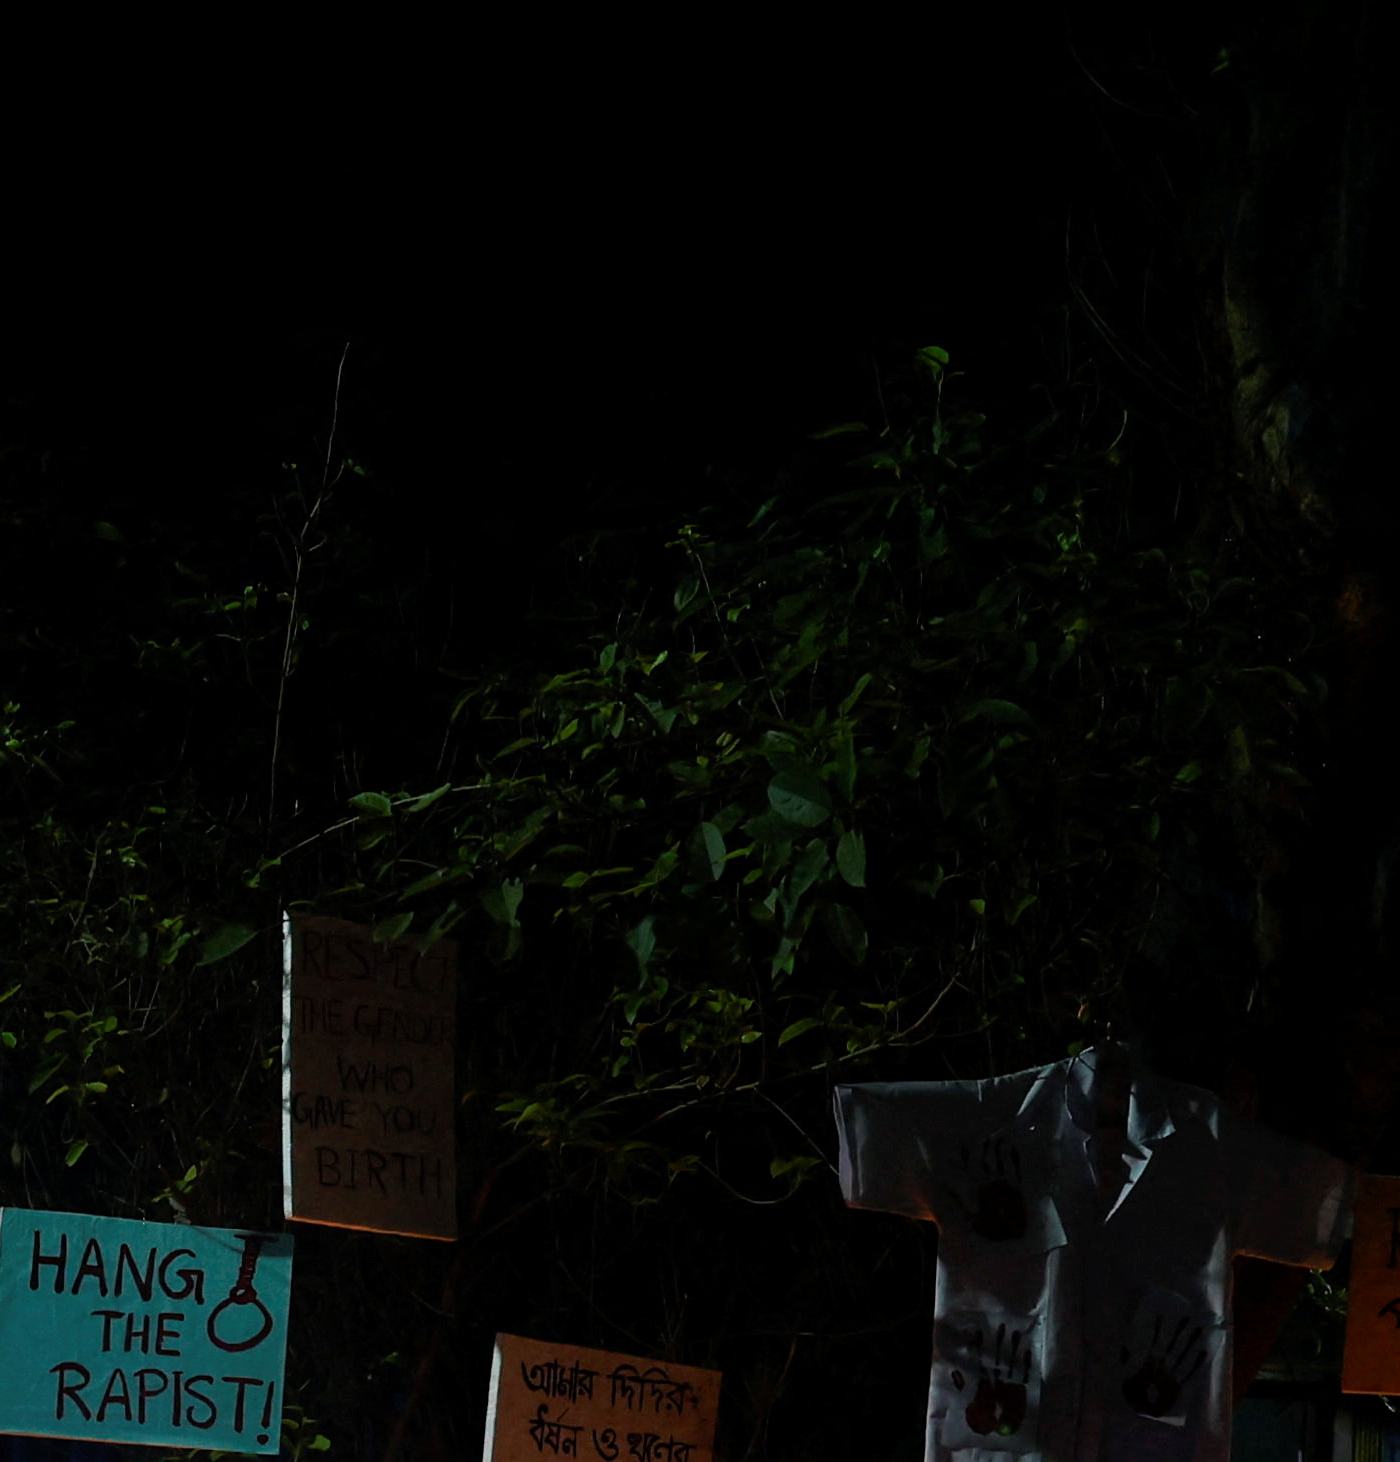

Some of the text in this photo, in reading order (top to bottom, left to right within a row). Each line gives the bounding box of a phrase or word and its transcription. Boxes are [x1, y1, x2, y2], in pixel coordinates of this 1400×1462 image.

[337, 1054, 415, 1094] WHO
[292, 1091, 437, 1137] GAVE YOU
[314, 1145, 442, 1200] BIRTH
[28, 1229, 205, 1305] HANG
[90, 1310, 185, 1356] THE
[49, 1361, 274, 1445] RAPIST!
[521, 1358, 693, 1416] আমার দিদির
[592, 1428, 619, 1461] ও
